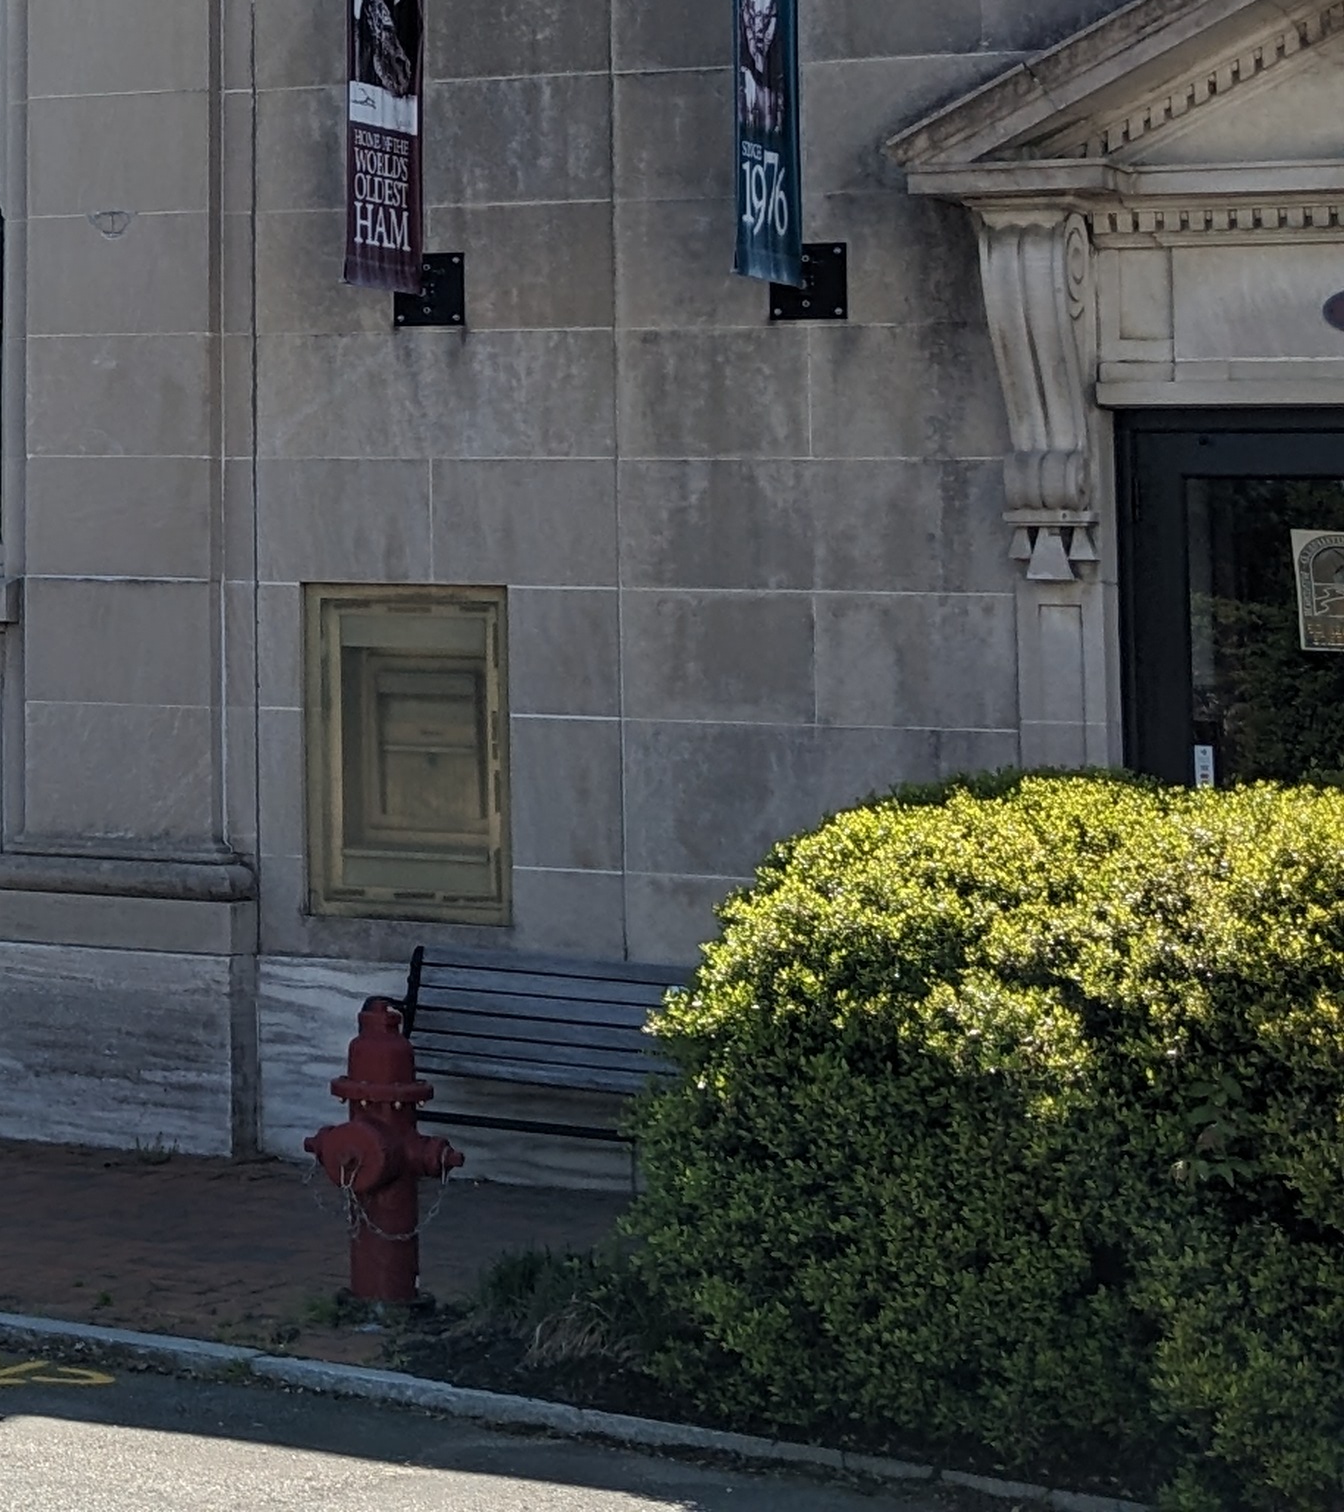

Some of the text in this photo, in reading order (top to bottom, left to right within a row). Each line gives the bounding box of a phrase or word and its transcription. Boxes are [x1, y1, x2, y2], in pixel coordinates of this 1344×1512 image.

[354, 173, 409, 208] OLDEST
[742, 149, 788, 237] 1976
[354, 201, 411, 252] HAM
